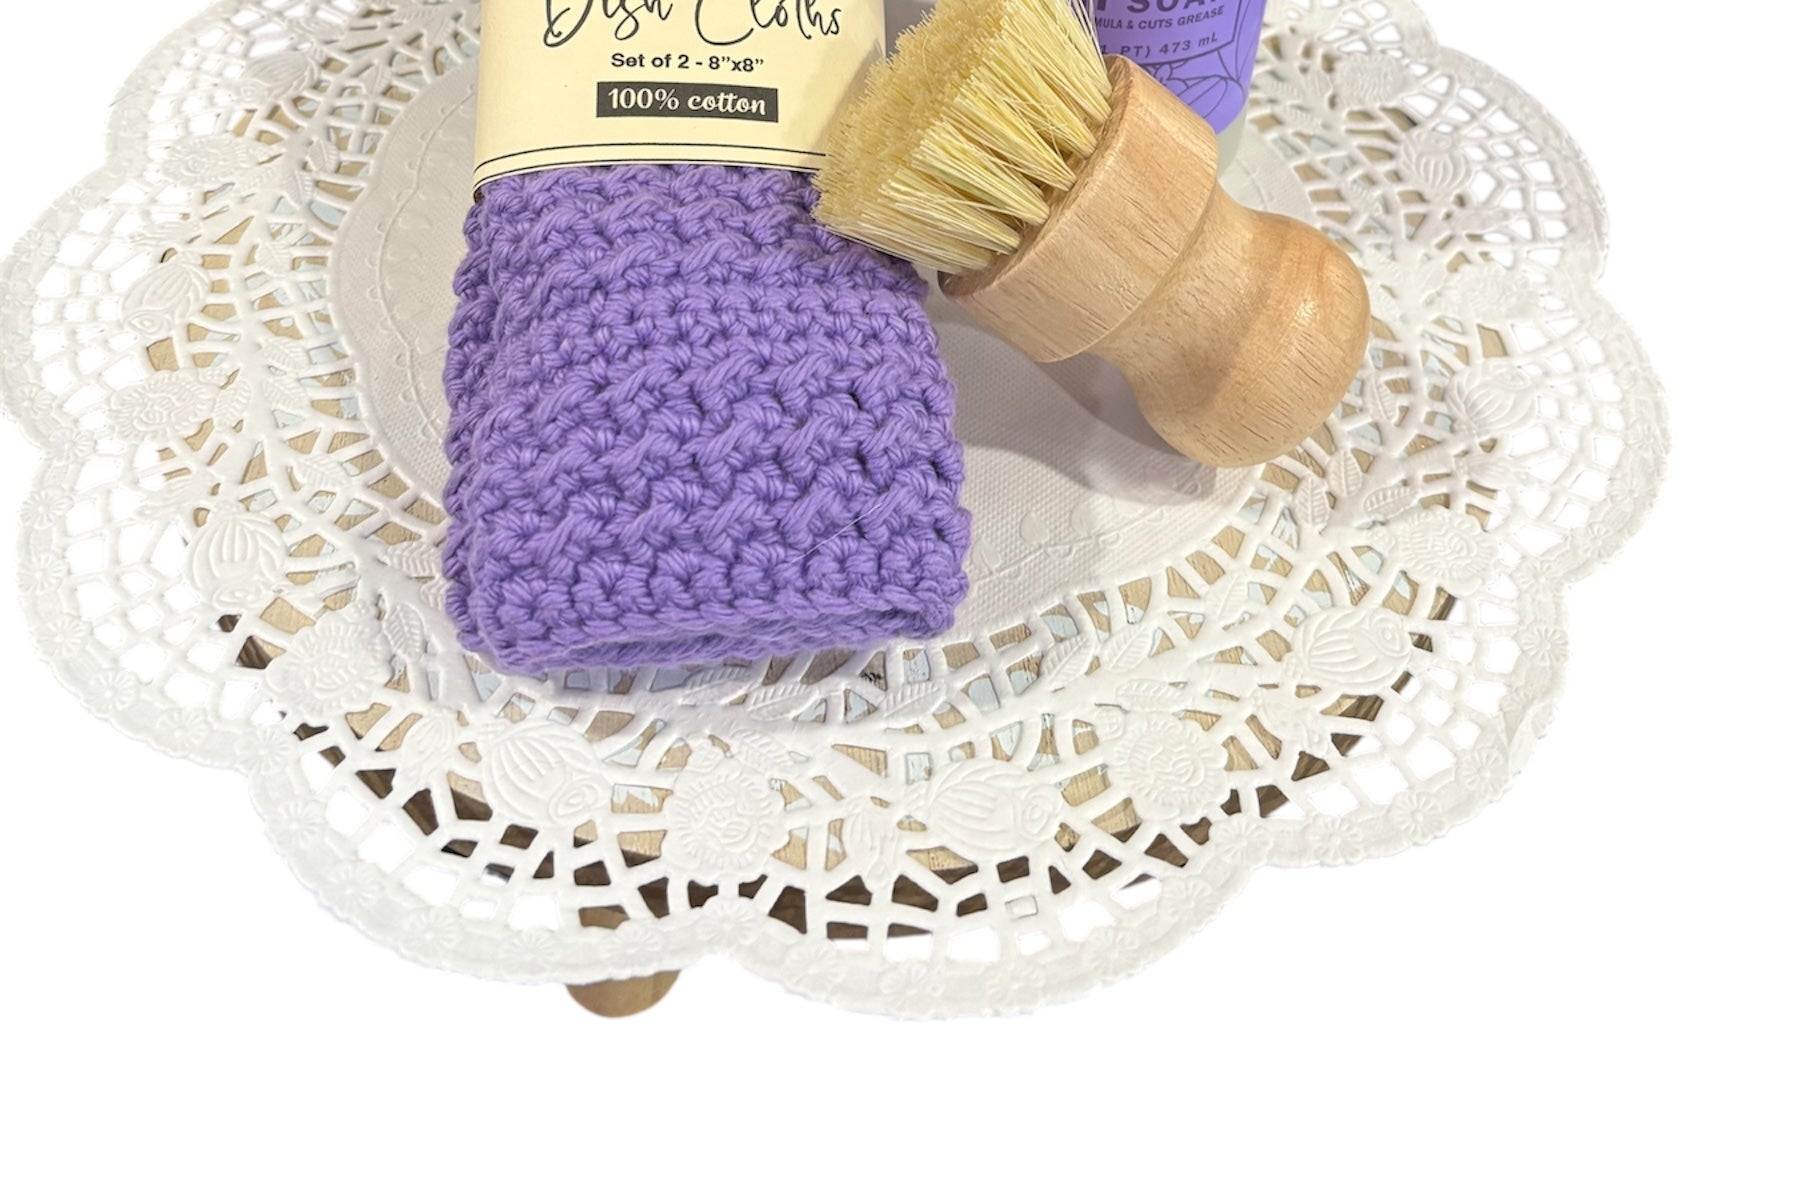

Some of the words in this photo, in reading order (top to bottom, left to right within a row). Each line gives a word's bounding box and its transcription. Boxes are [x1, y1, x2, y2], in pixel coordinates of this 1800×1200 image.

[1126, 18, 1134, 29] &
[1138, 17, 1173, 30] CUTS
[1177, 5, 1225, 26] GREASE
[1120, 45, 1150, 58] PT)
[1159, 40, 1191, 55] 473
[1198, 32, 1218, 47] mL
[611, 53, 645, 67] Set
[651, 54, 672, 68] of
[678, 54, 690, 69] 2
[608, 87, 680, 110] 100%
[687, 92, 767, 116] cotton
